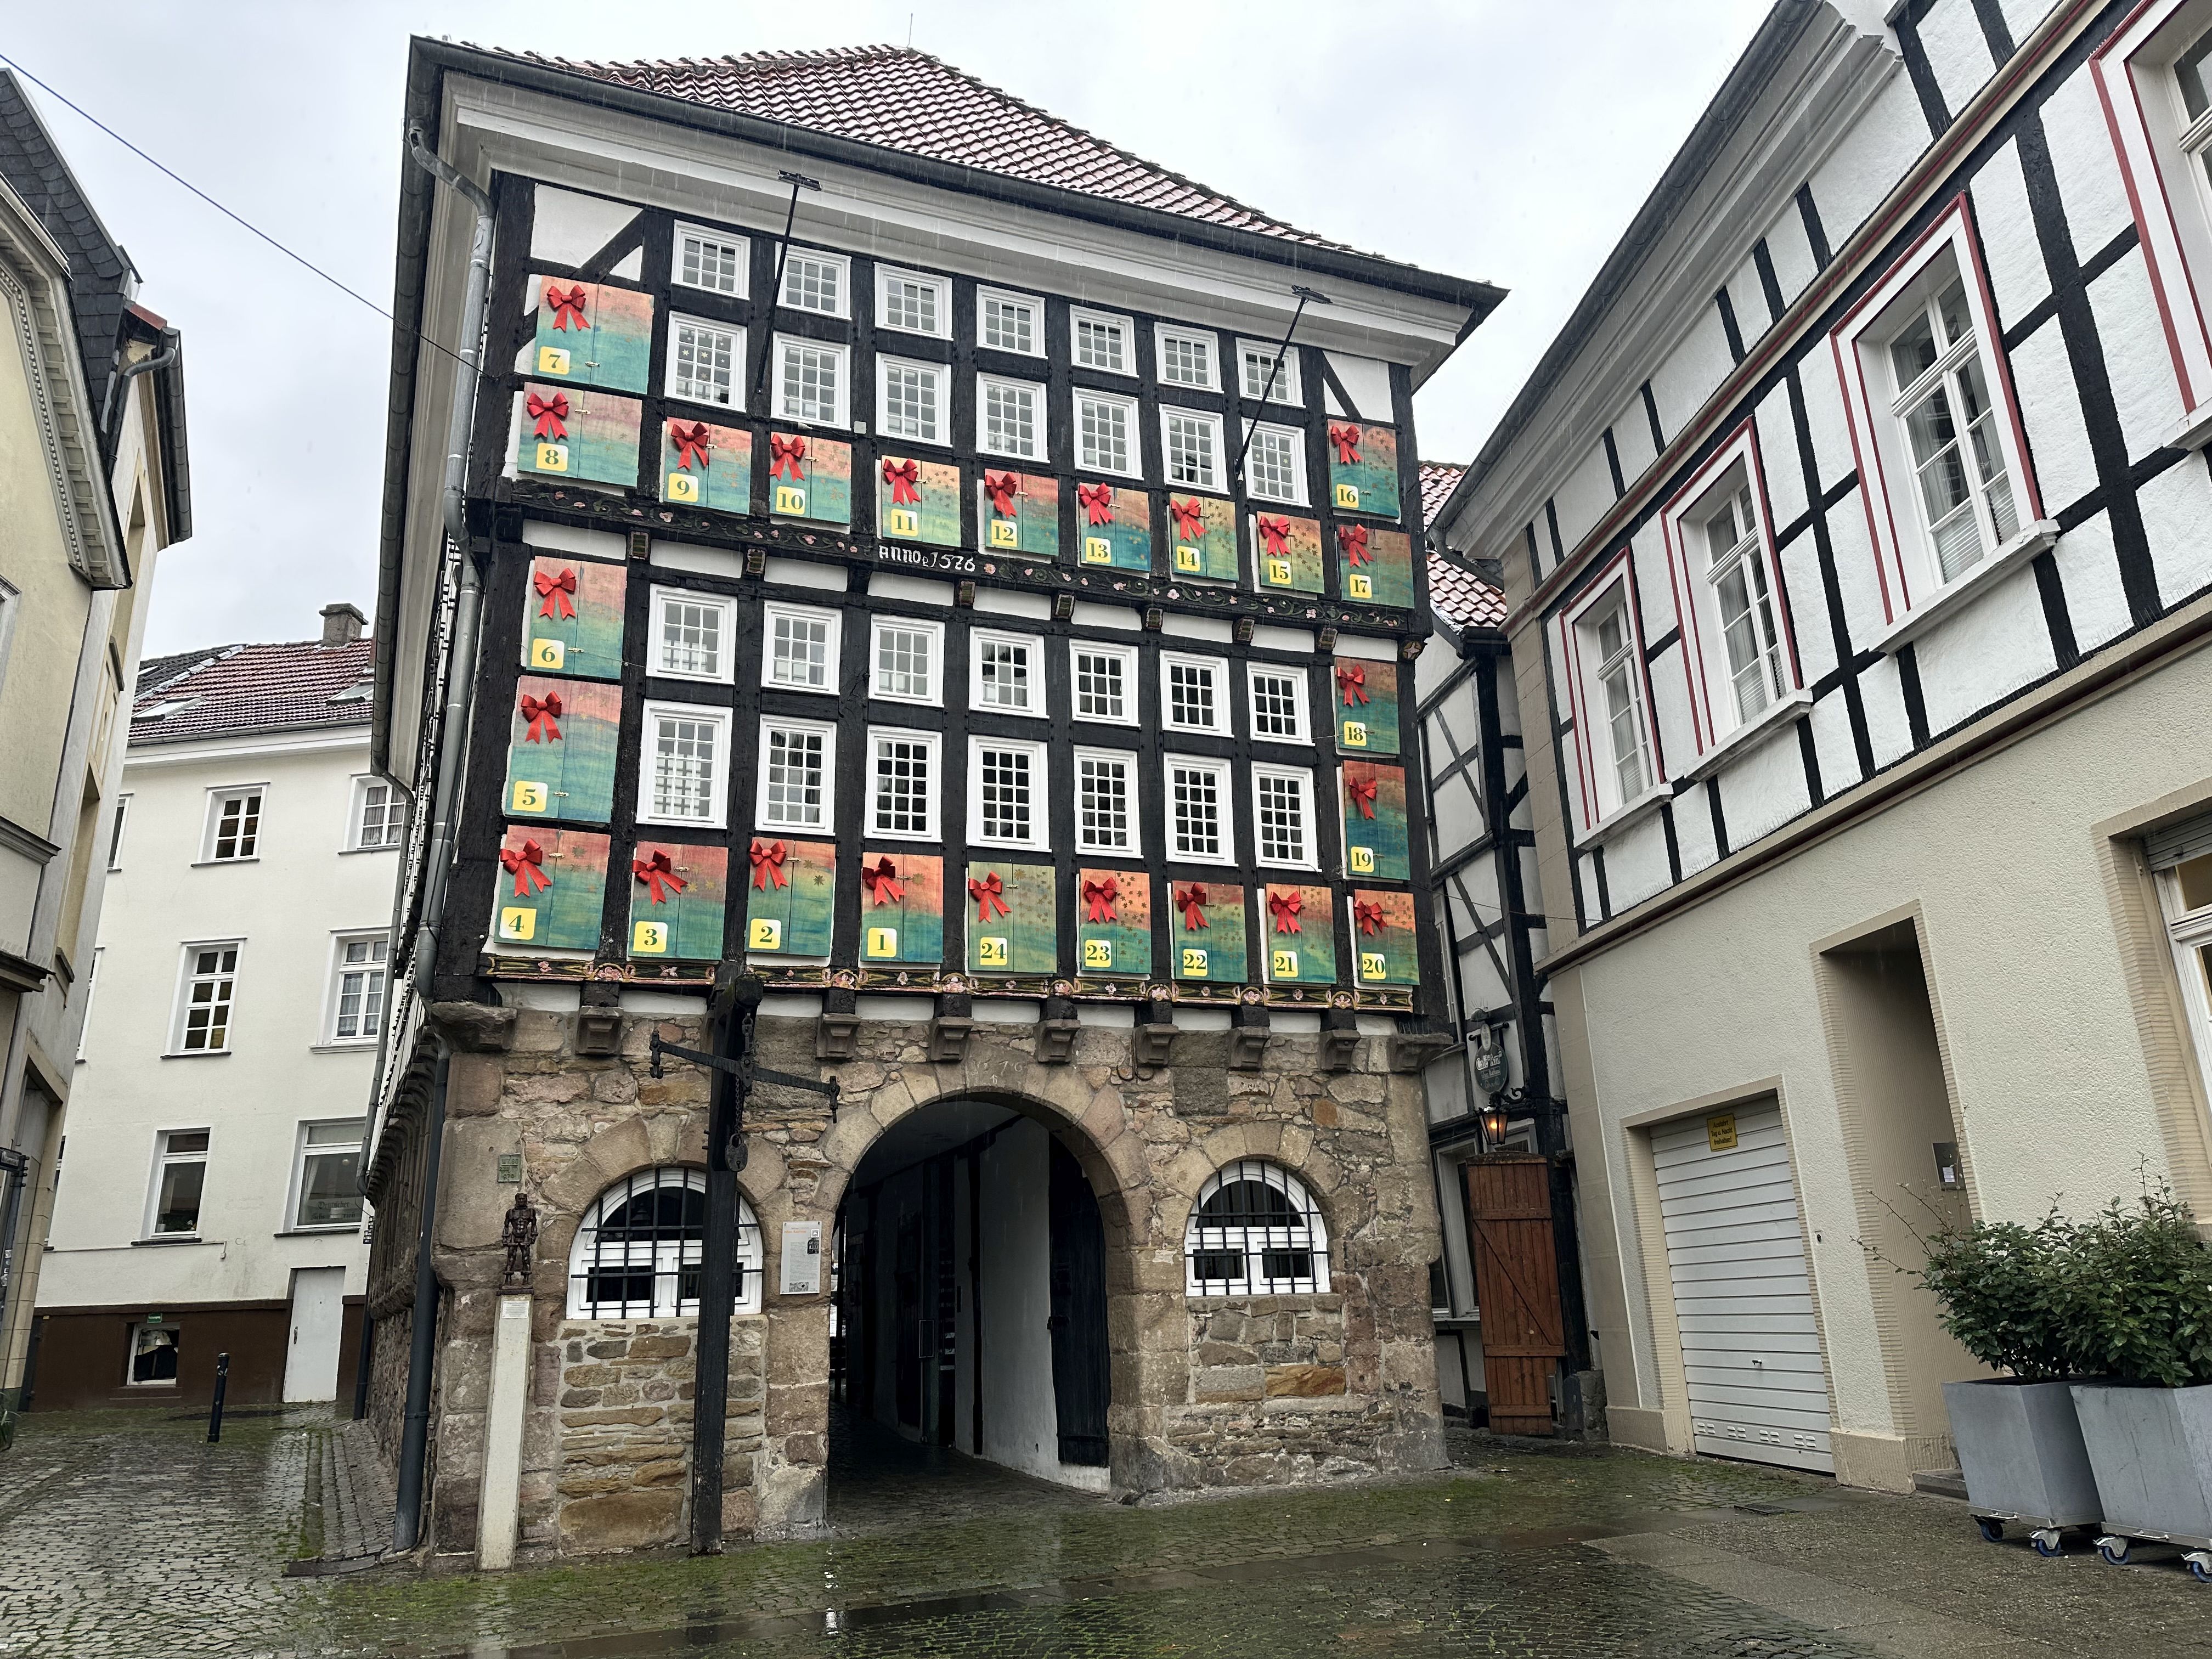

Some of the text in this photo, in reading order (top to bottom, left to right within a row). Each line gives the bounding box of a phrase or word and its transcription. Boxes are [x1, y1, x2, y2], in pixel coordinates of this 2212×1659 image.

[549, 354, 561, 368] 7
[545, 450, 558, 464] 8
[677, 481, 690, 495] 9
[780, 494, 803, 509] 10
[1340, 489, 1356, 503] 16
[896, 515, 913, 531] 11
[995, 526, 1013, 541] 12
[1091, 544, 1108, 557] 13
[1180, 551, 1197, 566] 14
[1272, 565, 1288, 579] 15
[1354, 579, 1368, 592] 17
[541, 646, 555, 662] 6
[1348, 727, 1363, 741] 18
[522, 789, 535, 805] 5
[1355, 853, 1371, 866] 19
[509, 915, 524, 932] 4
[645, 929, 657, 945] 3
[760, 927, 772, 943] 2
[878, 935, 885, 950] 1
[981, 943, 1006, 958] 24
[1087, 945, 1110, 961] 23
[1184, 954, 1206, 969] 22
[1276, 957, 1294, 972] 21
[1364, 959, 1385, 973] 20
[1713, 1120, 1729, 1128] Ausfahrt
[1714, 1136, 1733, 1145] freihalten!
